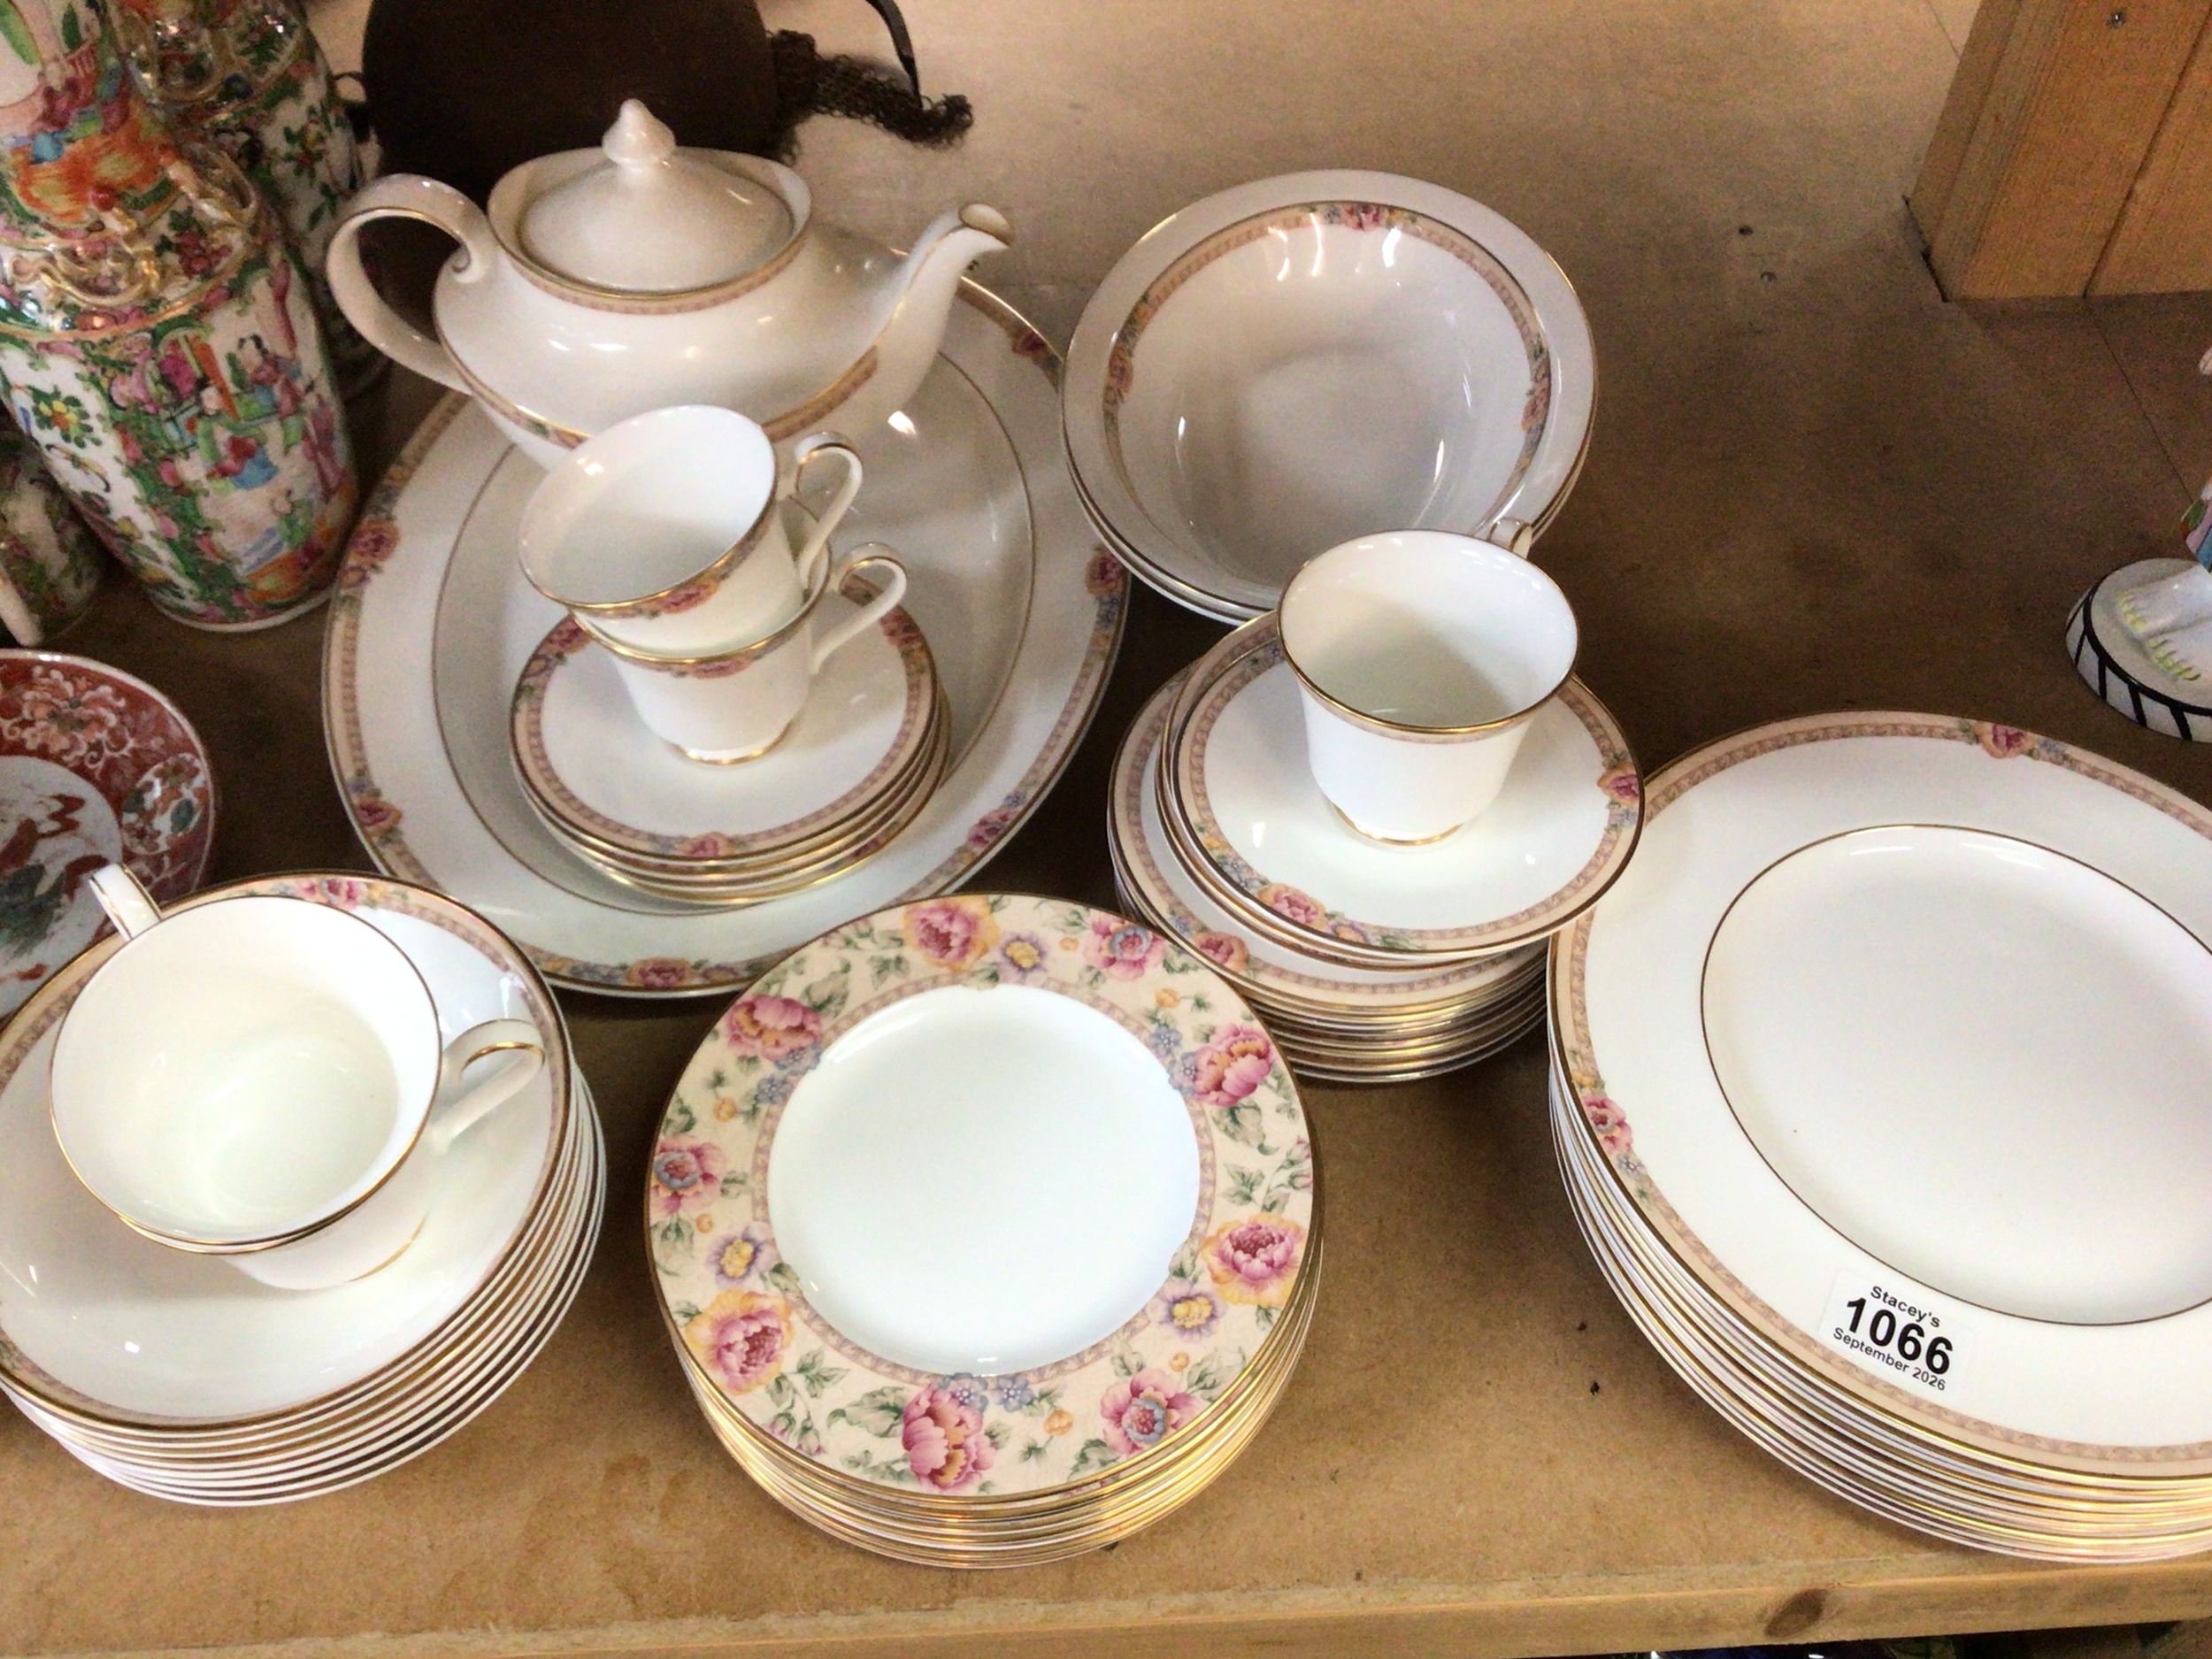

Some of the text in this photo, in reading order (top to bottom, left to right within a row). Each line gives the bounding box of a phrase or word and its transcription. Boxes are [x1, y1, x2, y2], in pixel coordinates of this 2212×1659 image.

[1847, 1297, 1953, 1374] 1066
[1870, 1286, 1940, 1328] Stacey's
[1833, 1327, 1947, 1391] September 2026
